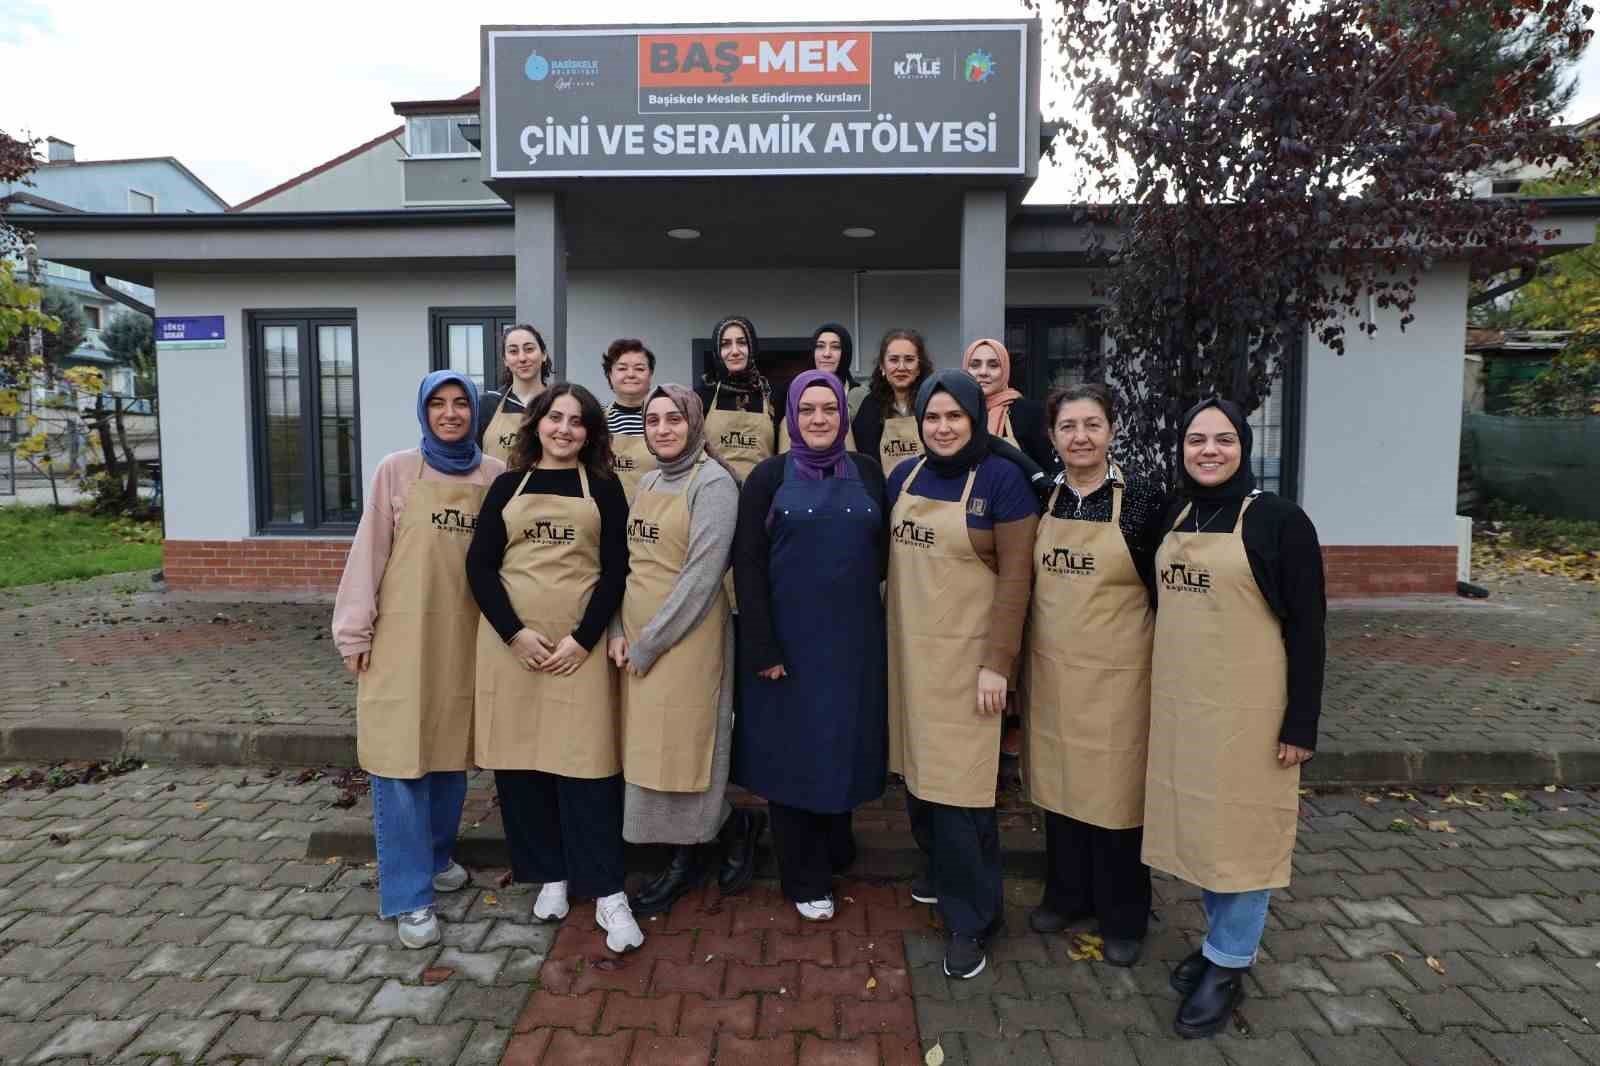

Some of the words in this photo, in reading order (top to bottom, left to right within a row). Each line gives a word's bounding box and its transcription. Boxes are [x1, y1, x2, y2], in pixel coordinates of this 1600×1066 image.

[650, 40, 859, 82] BAŞ-MEK
[648, 94, 704, 107] Başiskele
[707, 93, 749, 105] Meslek
[752, 92, 813, 104] Edindirme
[816, 92, 861, 103] Kursları
[520, 115, 589, 165] ÇİNİ
[597, 124, 645, 155] VE
[652, 114, 816, 154] SERAMİK
[823, 112, 997, 153] ATÖLYESİ
[720, 431, 757, 446] KALE
[523, 520, 575, 540] KALE
[892, 519, 935, 544] KALE
[1042, 548, 1095, 570] KALE
[1161, 564, 1210, 588] KALE
